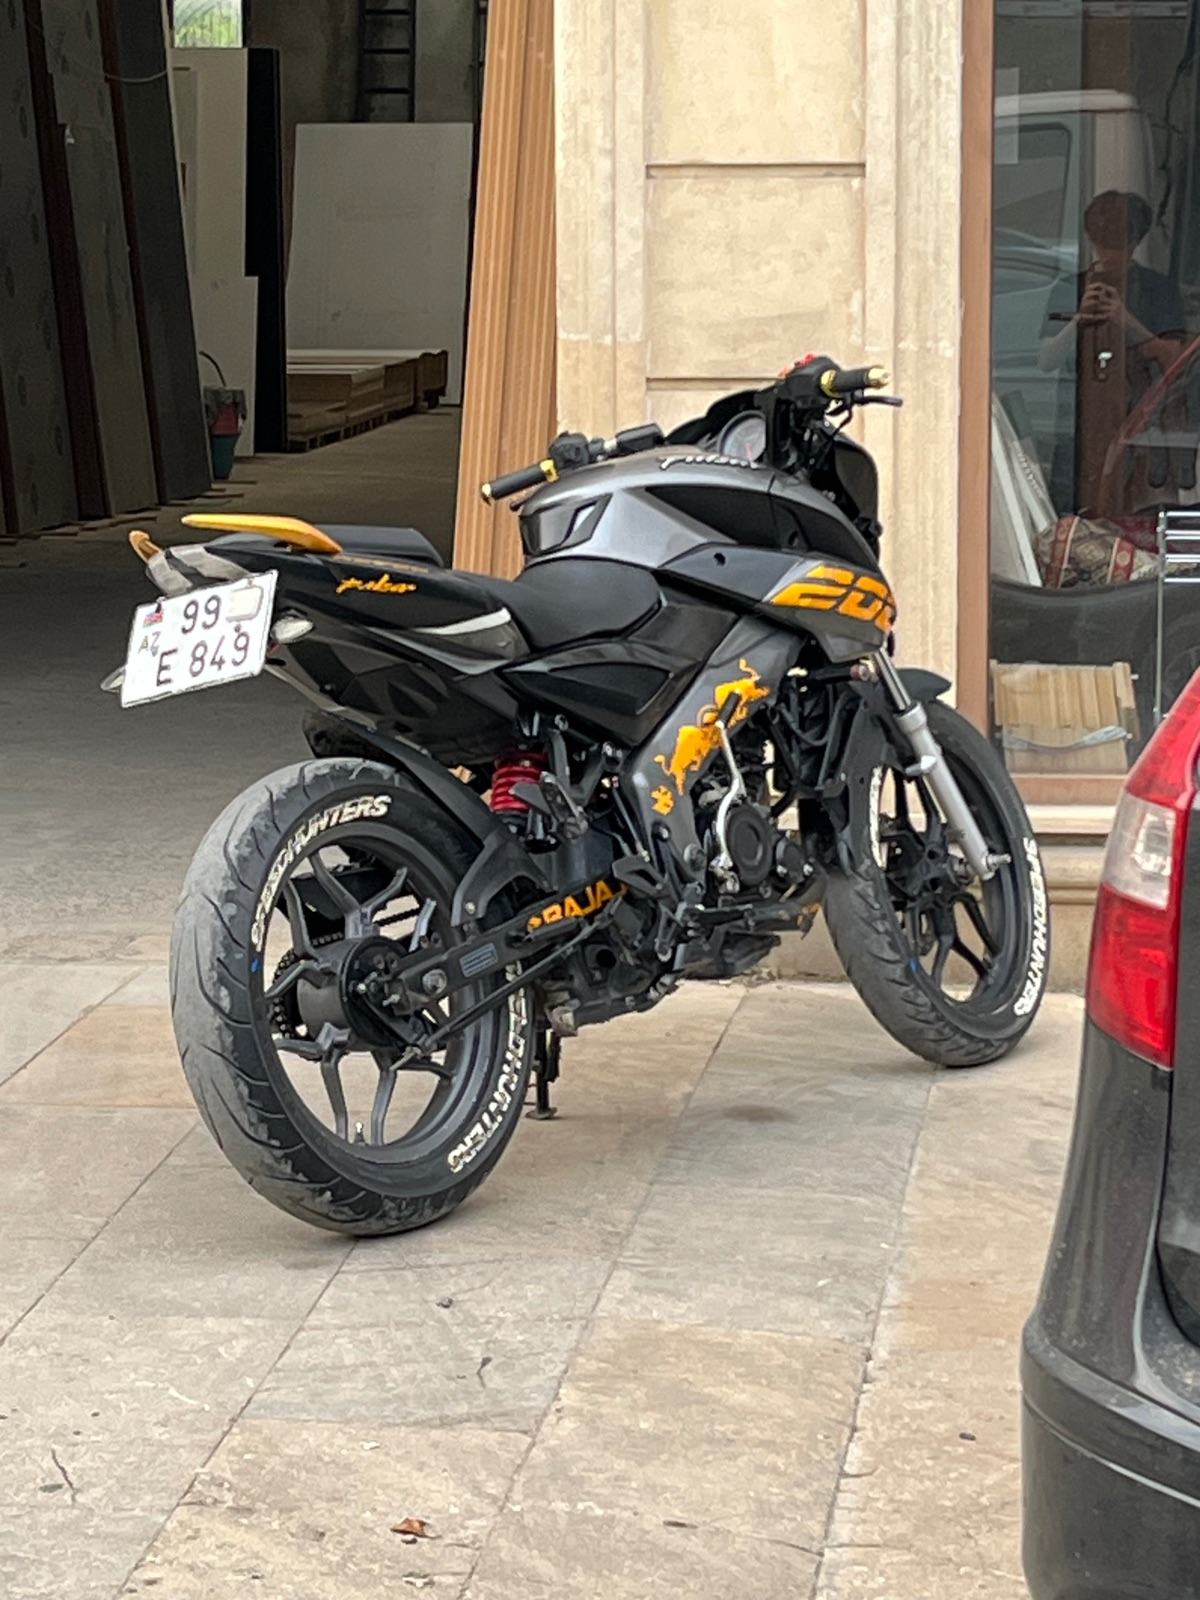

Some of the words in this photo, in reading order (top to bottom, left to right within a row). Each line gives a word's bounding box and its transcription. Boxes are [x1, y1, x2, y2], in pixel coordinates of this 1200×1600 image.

[181, 594, 222, 635] 99
[156, 648, 179, 687] E
[189, 631, 250, 678] 849
